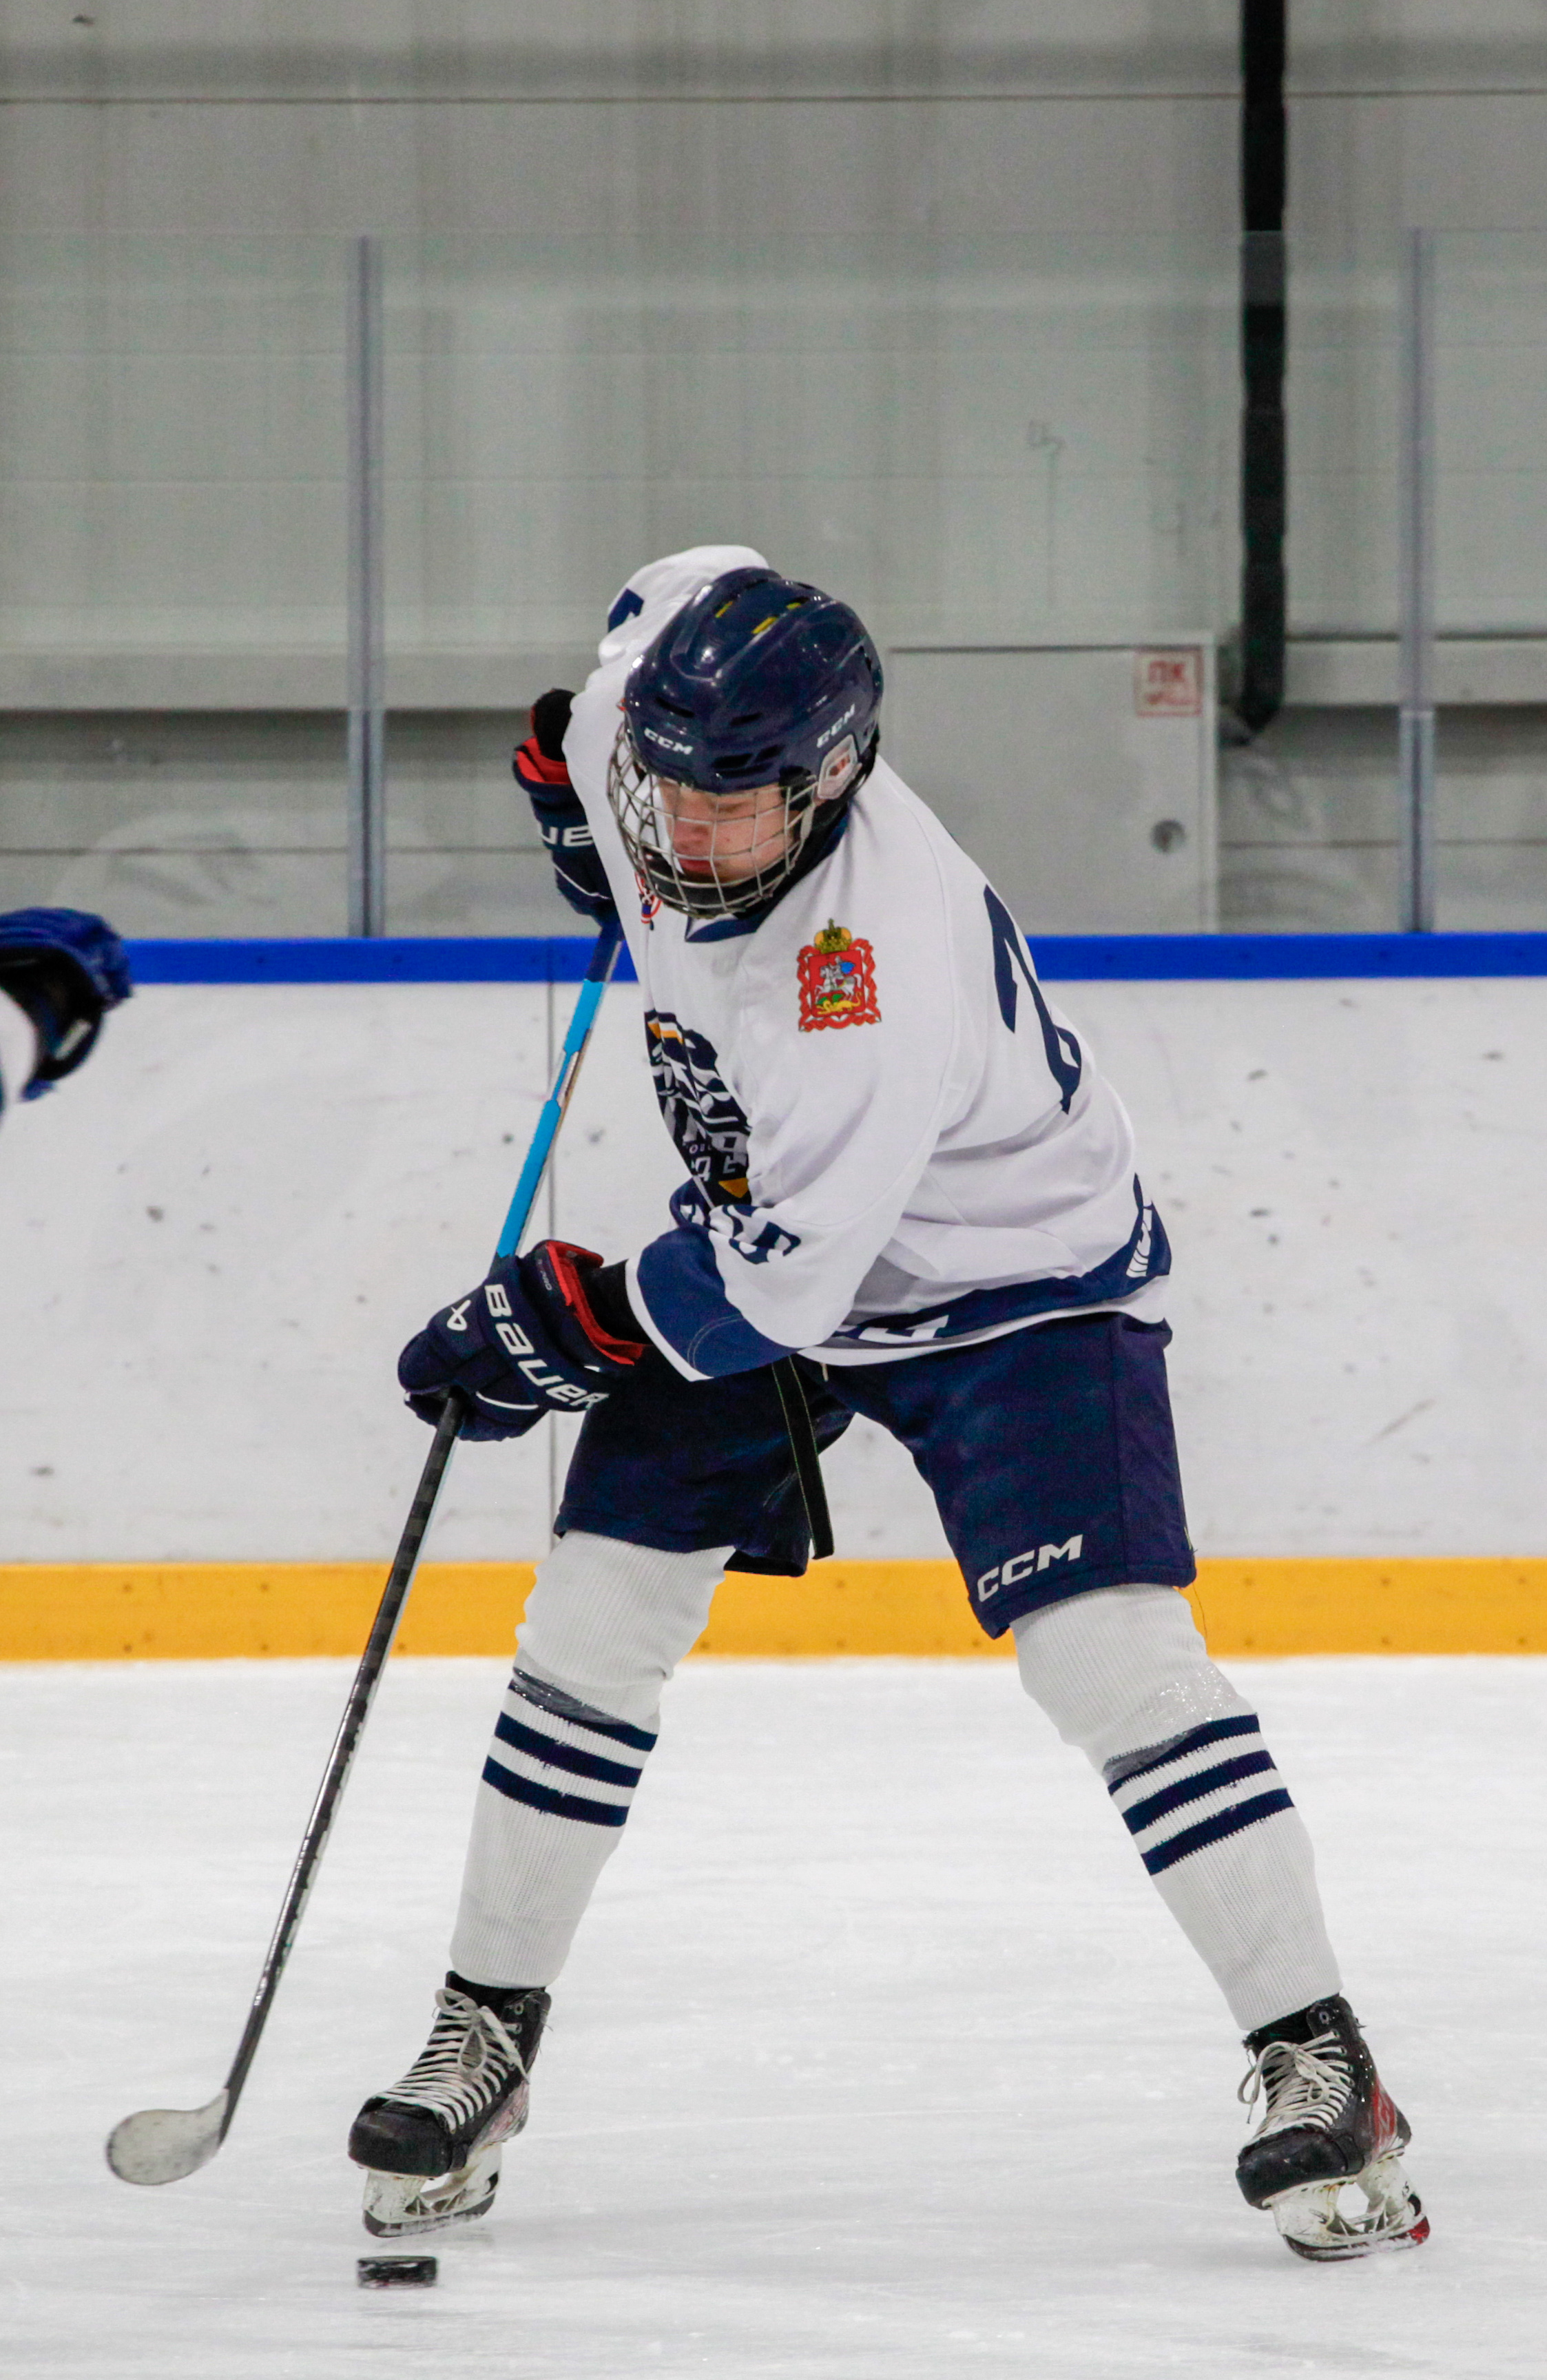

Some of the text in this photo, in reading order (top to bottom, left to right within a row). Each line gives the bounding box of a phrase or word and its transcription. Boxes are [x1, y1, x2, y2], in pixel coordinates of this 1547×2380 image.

[644, 727, 694, 755] CCM
[816, 703, 855, 748] CCM
[977, 1534, 1083, 1602] CCM
